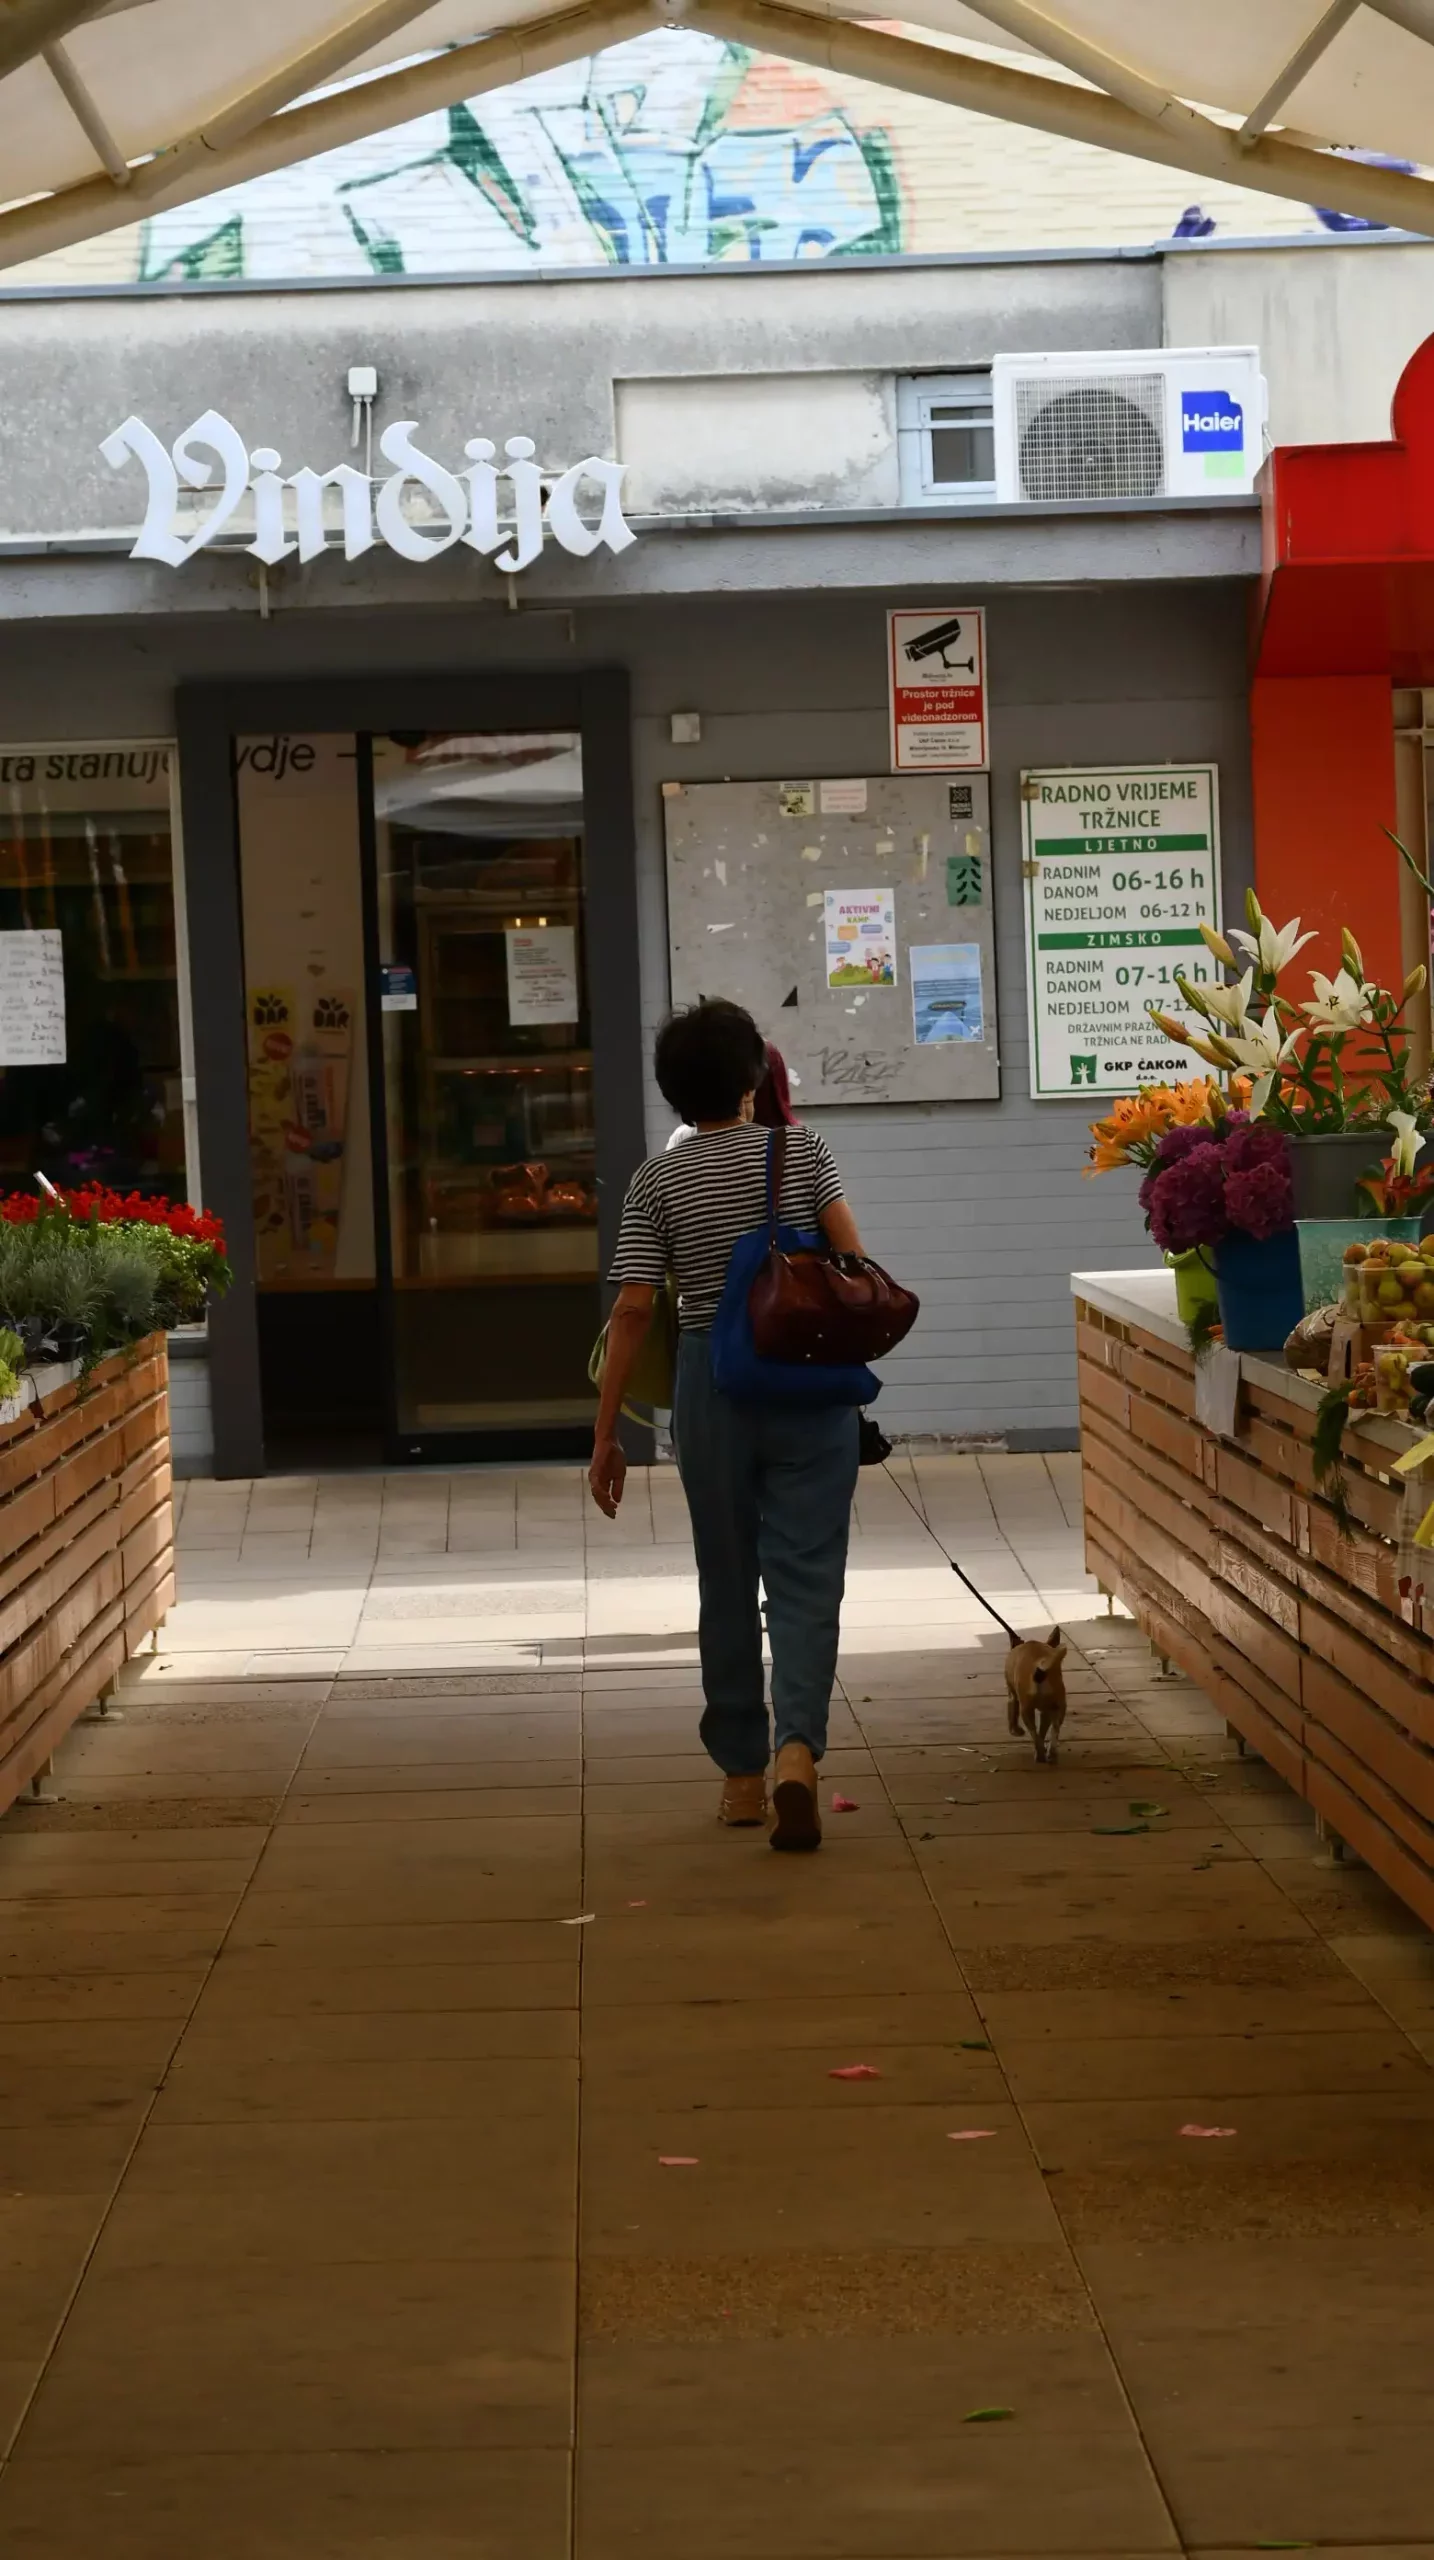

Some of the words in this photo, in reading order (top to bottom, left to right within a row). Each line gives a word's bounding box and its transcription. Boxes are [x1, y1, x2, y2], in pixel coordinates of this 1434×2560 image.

[1183, 412, 1241, 432] Haier
[99, 409, 637, 572] Vindija
[902, 689, 939, 699] Prostor
[941, 688, 975, 698] tržnice
[923, 701, 933, 712] je
[935, 700, 955, 711] pod
[901, 712, 978, 722] videonadzorom
[1042, 783, 1111, 804] RADNO
[1116, 781, 1198, 801] VRIJEME
[1079, 807, 1161, 829] TRŽNICE
[1085, 838, 1158, 852] LJETNO
[1043, 865, 1101, 880] RADNIM
[1112, 868, 1184, 891] 06-16
[1191, 867, 1205, 889] h
[1043, 885, 1099, 900] DANOM
[838, 904, 880, 915] AKTIVNI
[1044, 906, 1127, 922] NEDJELJOM
[1140, 903, 1190, 919] 06-12
[1196, 901, 1206, 917] h
[1086, 932, 1162, 947] ZIMSKO
[1046, 960, 1104, 975] RADNIM
[1115, 963, 1187, 987] 07-16
[1194, 962, 1207, 983] h
[1047, 980, 1101, 994] DANOM
[1047, 1001, 1130, 1016] NEDJELJOM
[1067, 1021, 1122, 1034] DRŽAVNIM
[1083, 1035, 1128, 1047] TRŽNICA
[1129, 1035, 1144, 1046] NE
[1104, 1060, 1133, 1072] GKP
[1137, 1057, 1188, 1071] ČAKOM
